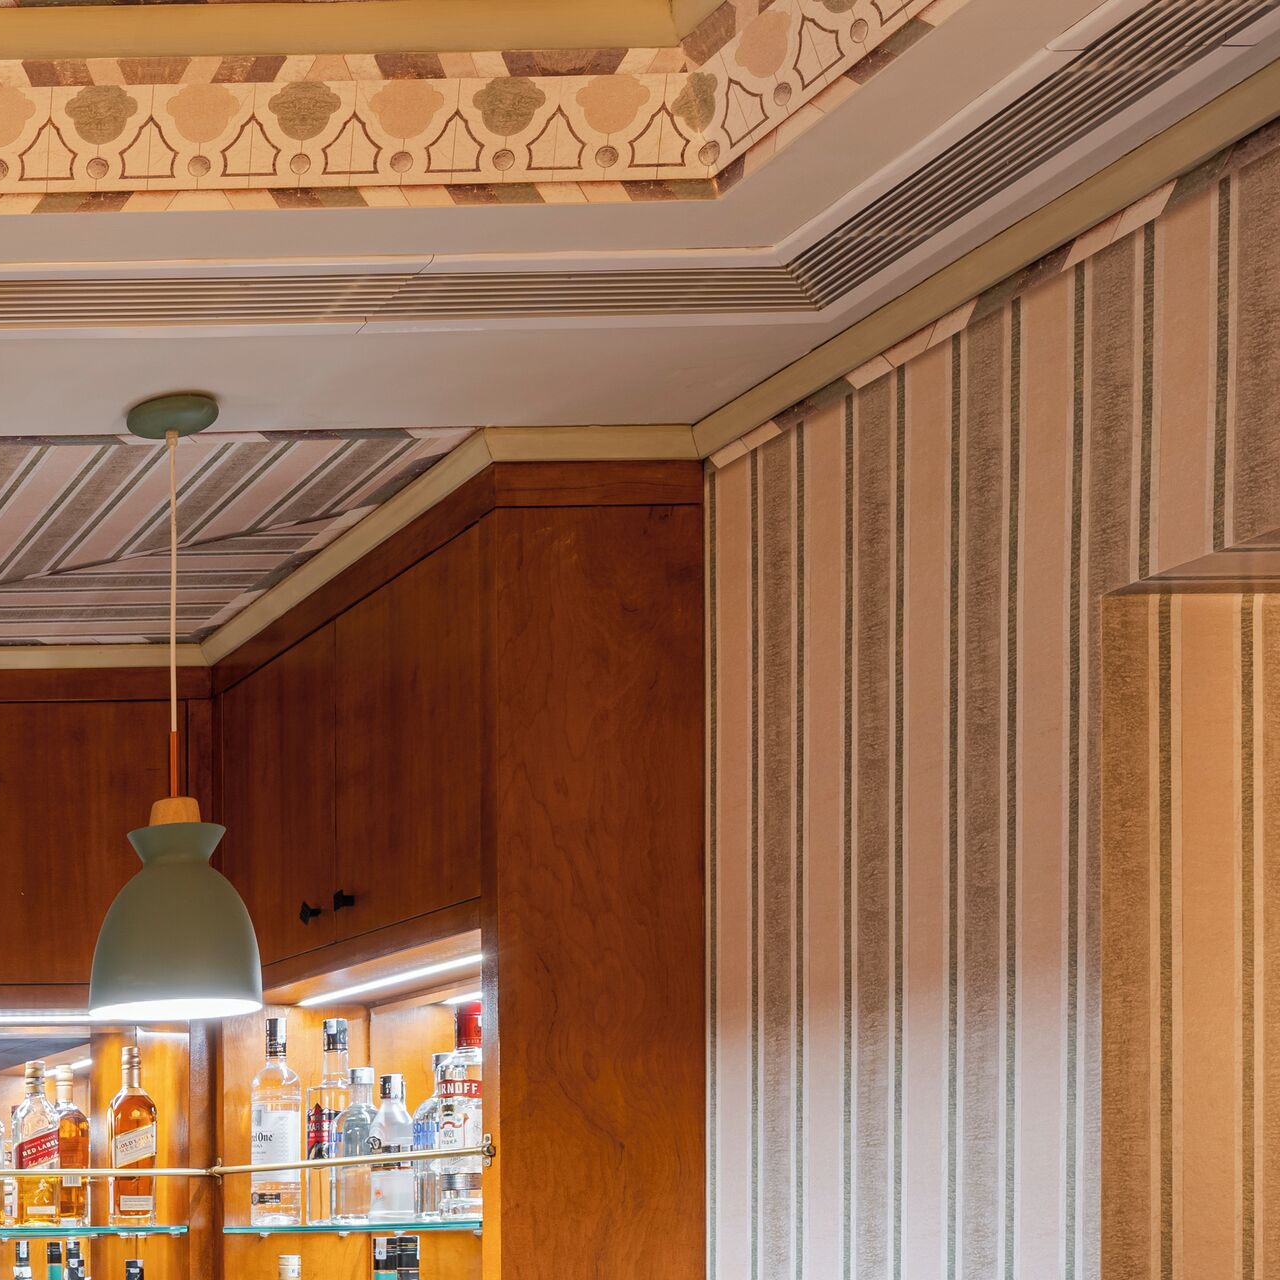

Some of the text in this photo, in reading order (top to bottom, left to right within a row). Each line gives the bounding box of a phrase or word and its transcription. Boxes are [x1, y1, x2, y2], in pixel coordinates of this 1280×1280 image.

[441, 1082, 479, 1094] RNOFF
[22, 1139, 59, 1157] RED LABEL
